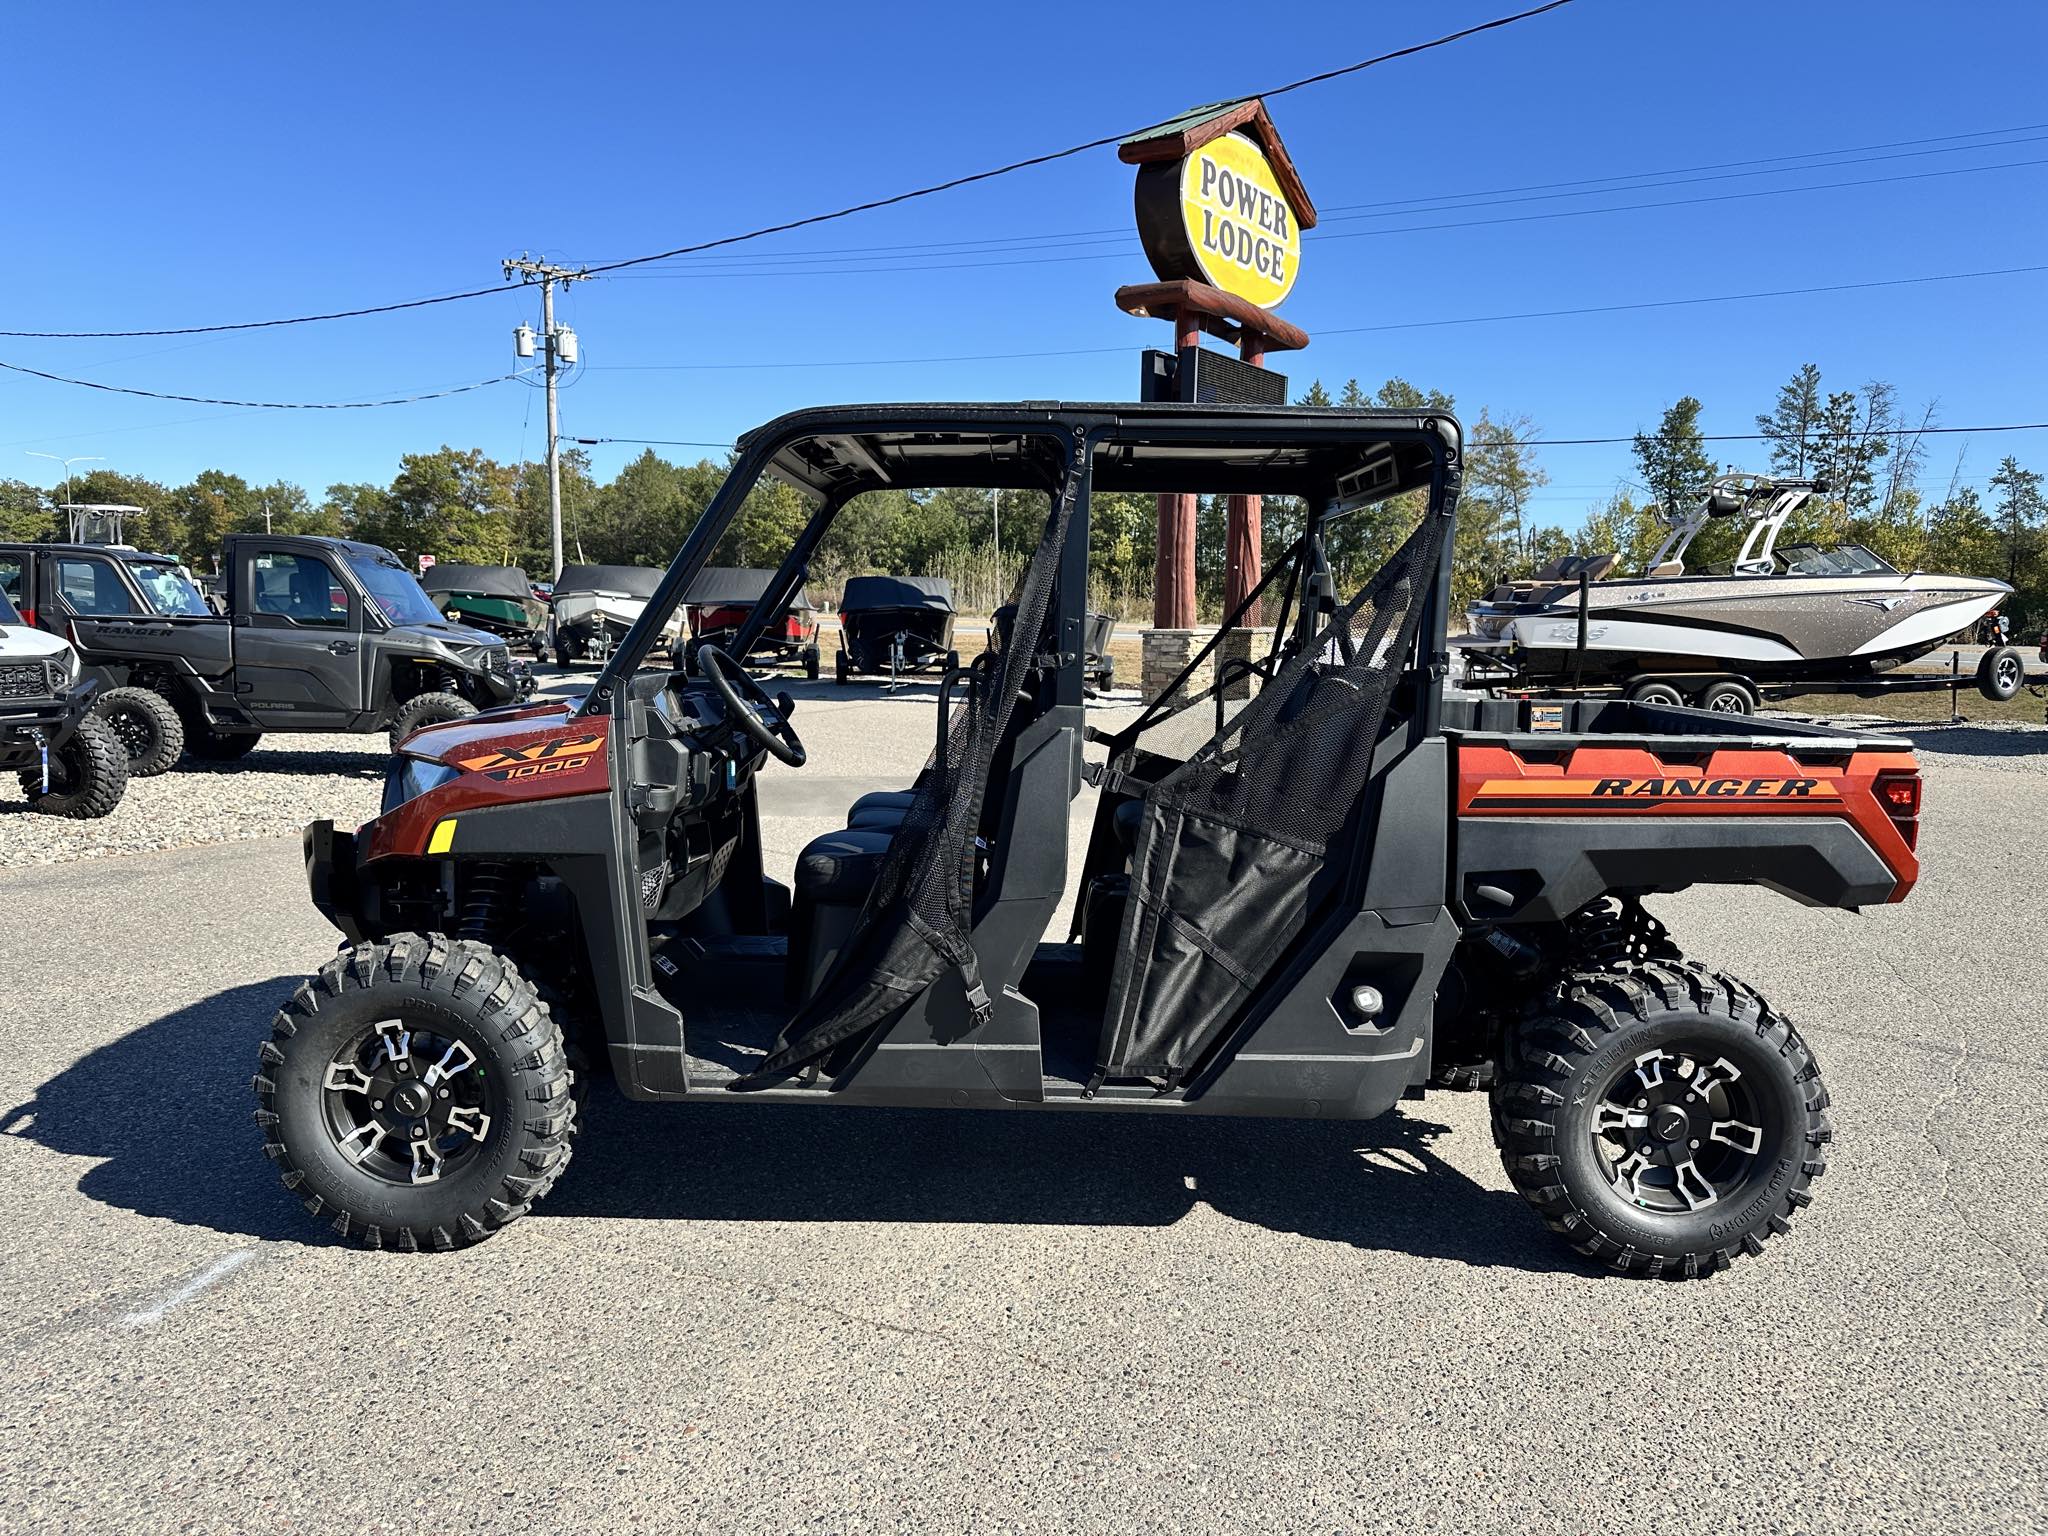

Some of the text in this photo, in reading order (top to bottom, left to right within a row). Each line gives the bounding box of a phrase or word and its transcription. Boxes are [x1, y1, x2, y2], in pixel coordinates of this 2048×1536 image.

[1202, 158, 1288, 240] POWER
[1203, 209, 1284, 282] LODGE
[96, 626, 174, 637] RANGER
[250, 702, 295, 710] POLARIS
[480, 734, 600, 769] XP
[506, 757, 589, 779] 1000
[1591, 778, 1818, 796] RANGER
